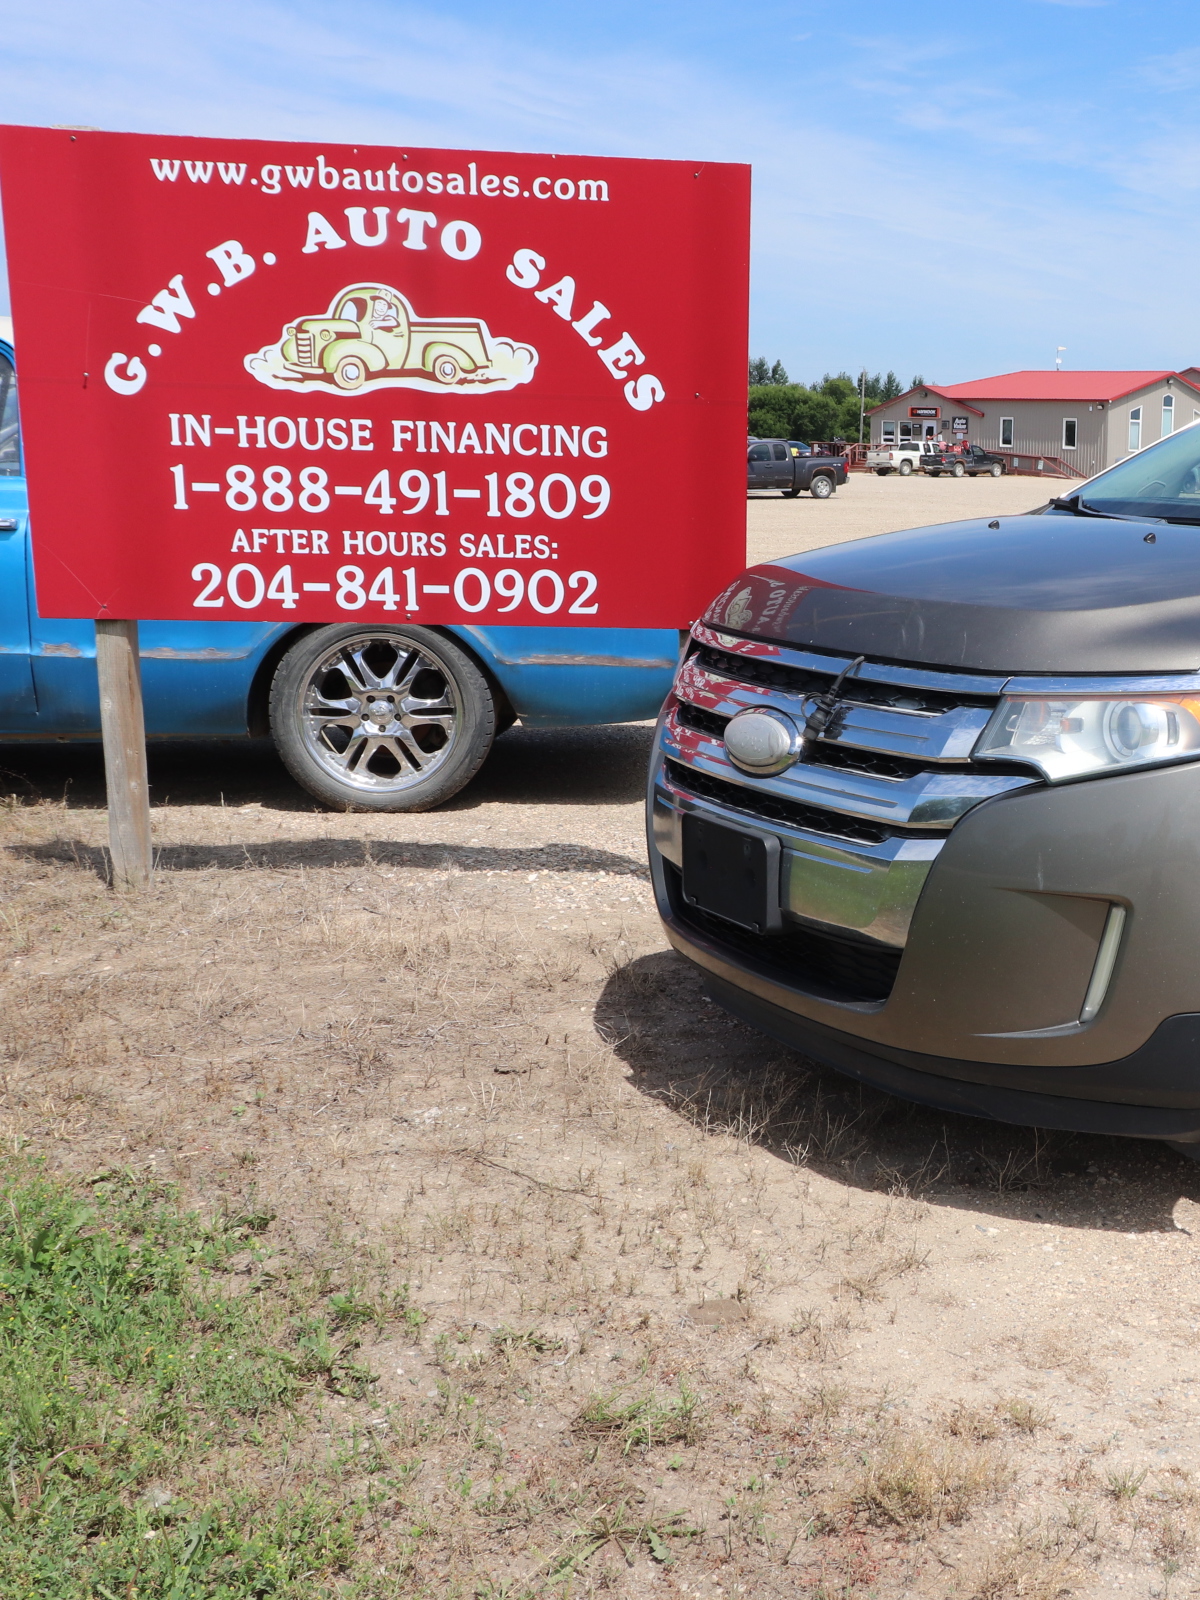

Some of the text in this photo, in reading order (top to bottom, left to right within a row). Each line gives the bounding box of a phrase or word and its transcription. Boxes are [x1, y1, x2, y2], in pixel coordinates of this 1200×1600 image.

[149, 154, 610, 202] www.gwbautosales.com
[103, 206, 666, 412] G.W.B. AUTO SALES
[168, 413, 608, 459] IN-HOUSE FINANCING
[169, 463, 611, 520] 1-888-491-1809
[230, 528, 559, 560] AFTER HOURS SALES:
[191, 562, 599, 615] 204-841-0902
